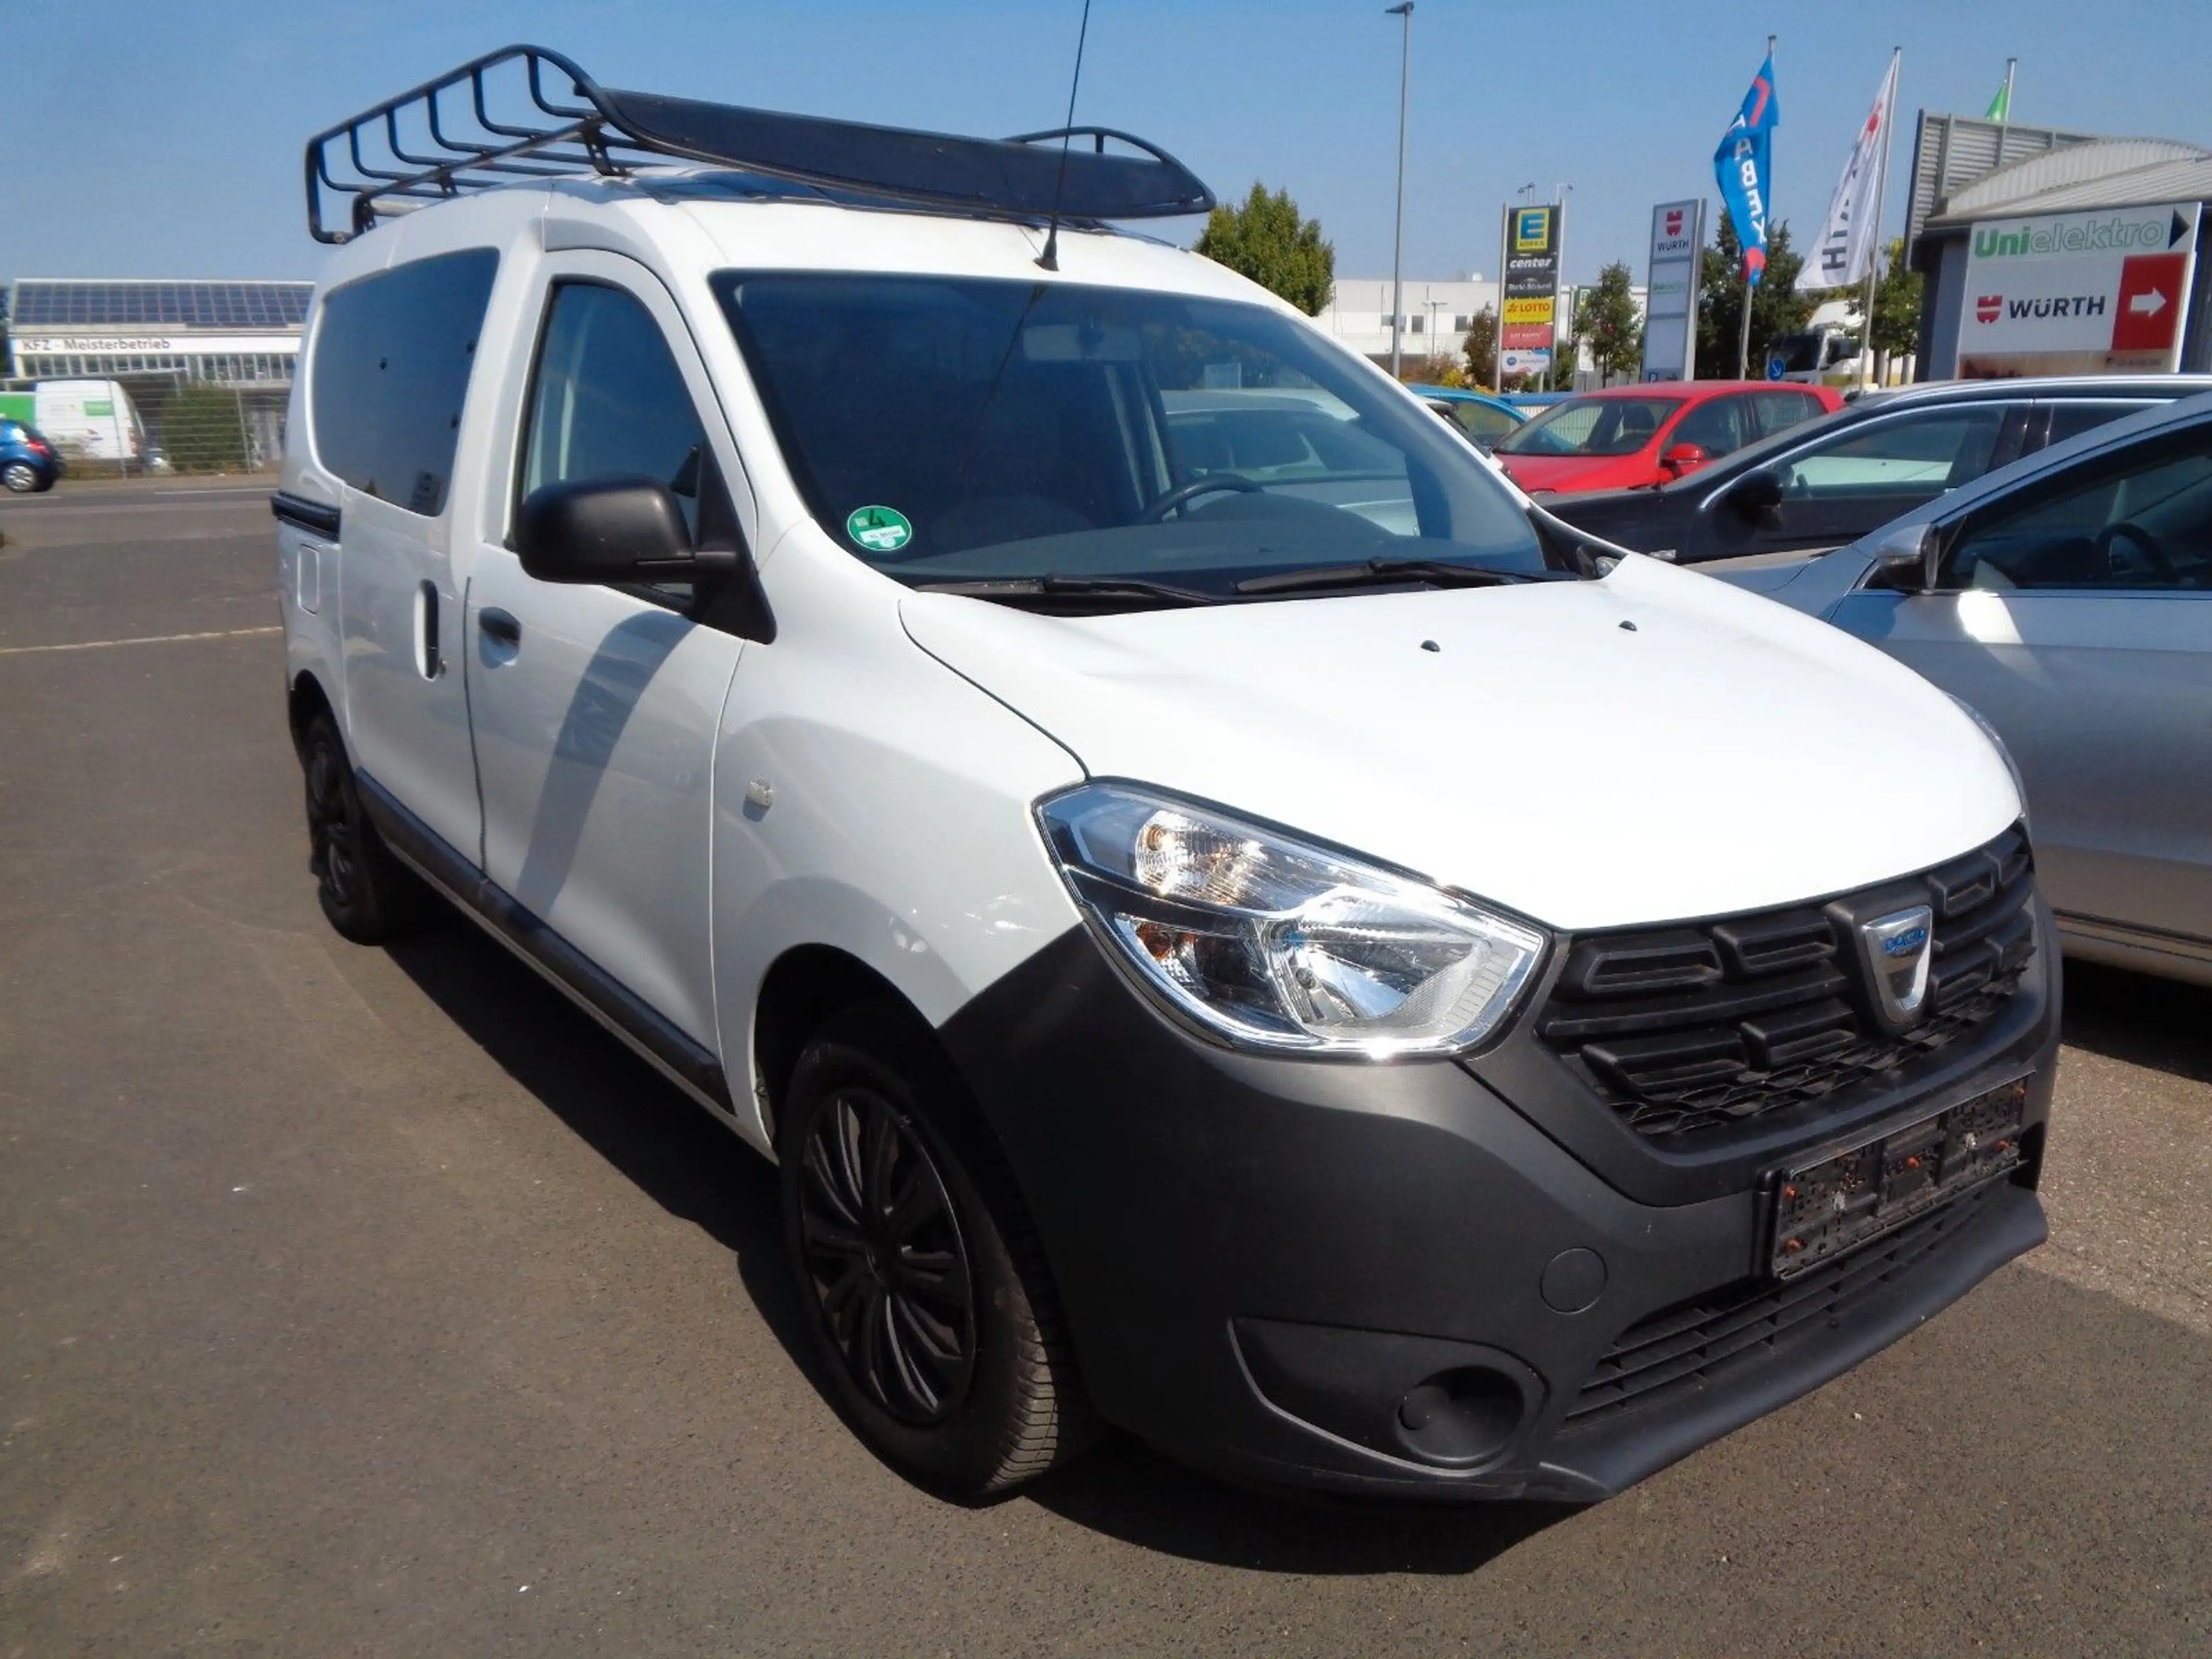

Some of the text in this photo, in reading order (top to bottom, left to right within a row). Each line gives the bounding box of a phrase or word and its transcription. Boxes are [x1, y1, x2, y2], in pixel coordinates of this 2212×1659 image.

[1521, 213, 1545, 240] E
[1974, 217, 2165, 259] Unielektro
[1657, 240, 1689, 252] WÜRTH
[1509, 257, 1552, 269] center
[1520, 303, 1550, 313] LOTTO
[2009, 296, 2106, 319] WÜRTH
[22, 340, 51, 351] KFZ
[63, 338, 171, 351] Meisterbetrieb
[869, 509, 886, 527] 4
